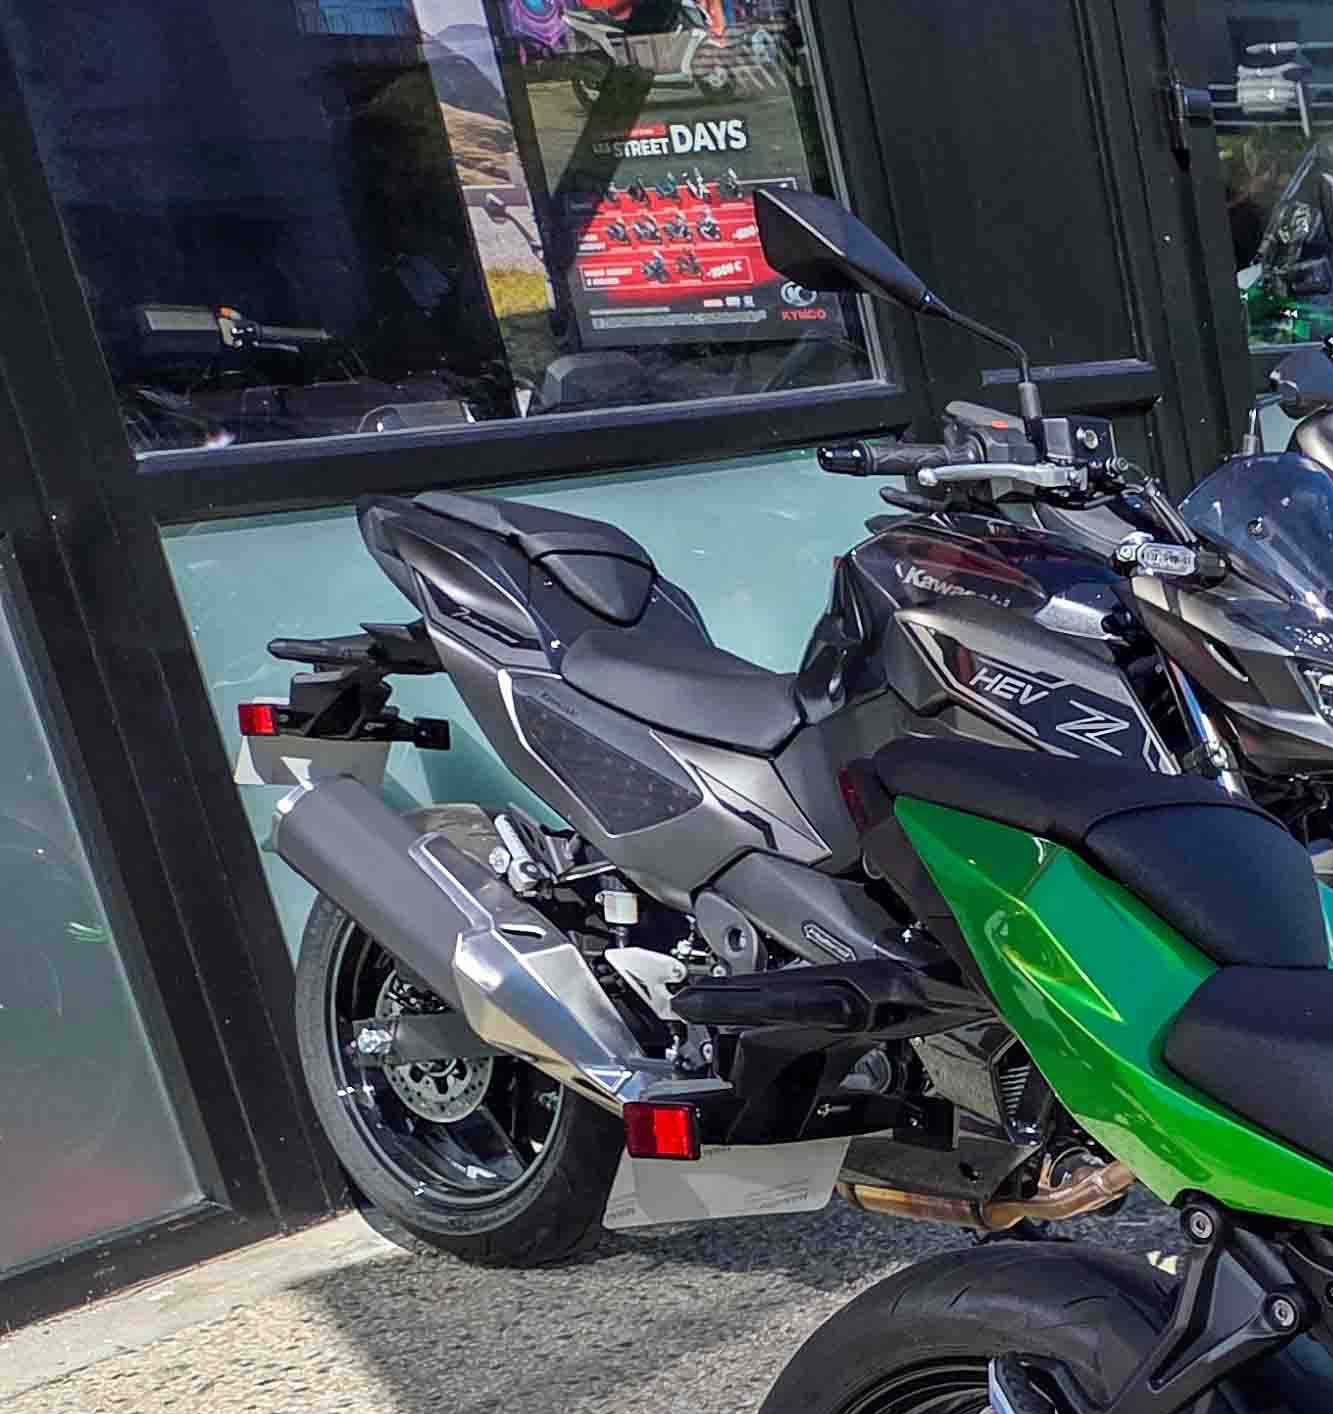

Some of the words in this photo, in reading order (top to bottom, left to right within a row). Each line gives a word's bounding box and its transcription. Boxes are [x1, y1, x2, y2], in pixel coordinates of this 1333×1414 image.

[613, 137, 669, 157] STREET
[669, 119, 748, 154] DAYS
[782, 308, 827, 321] KYMCO
[904, 567, 1011, 608] Kawa
[969, 667, 1049, 706] HEV
